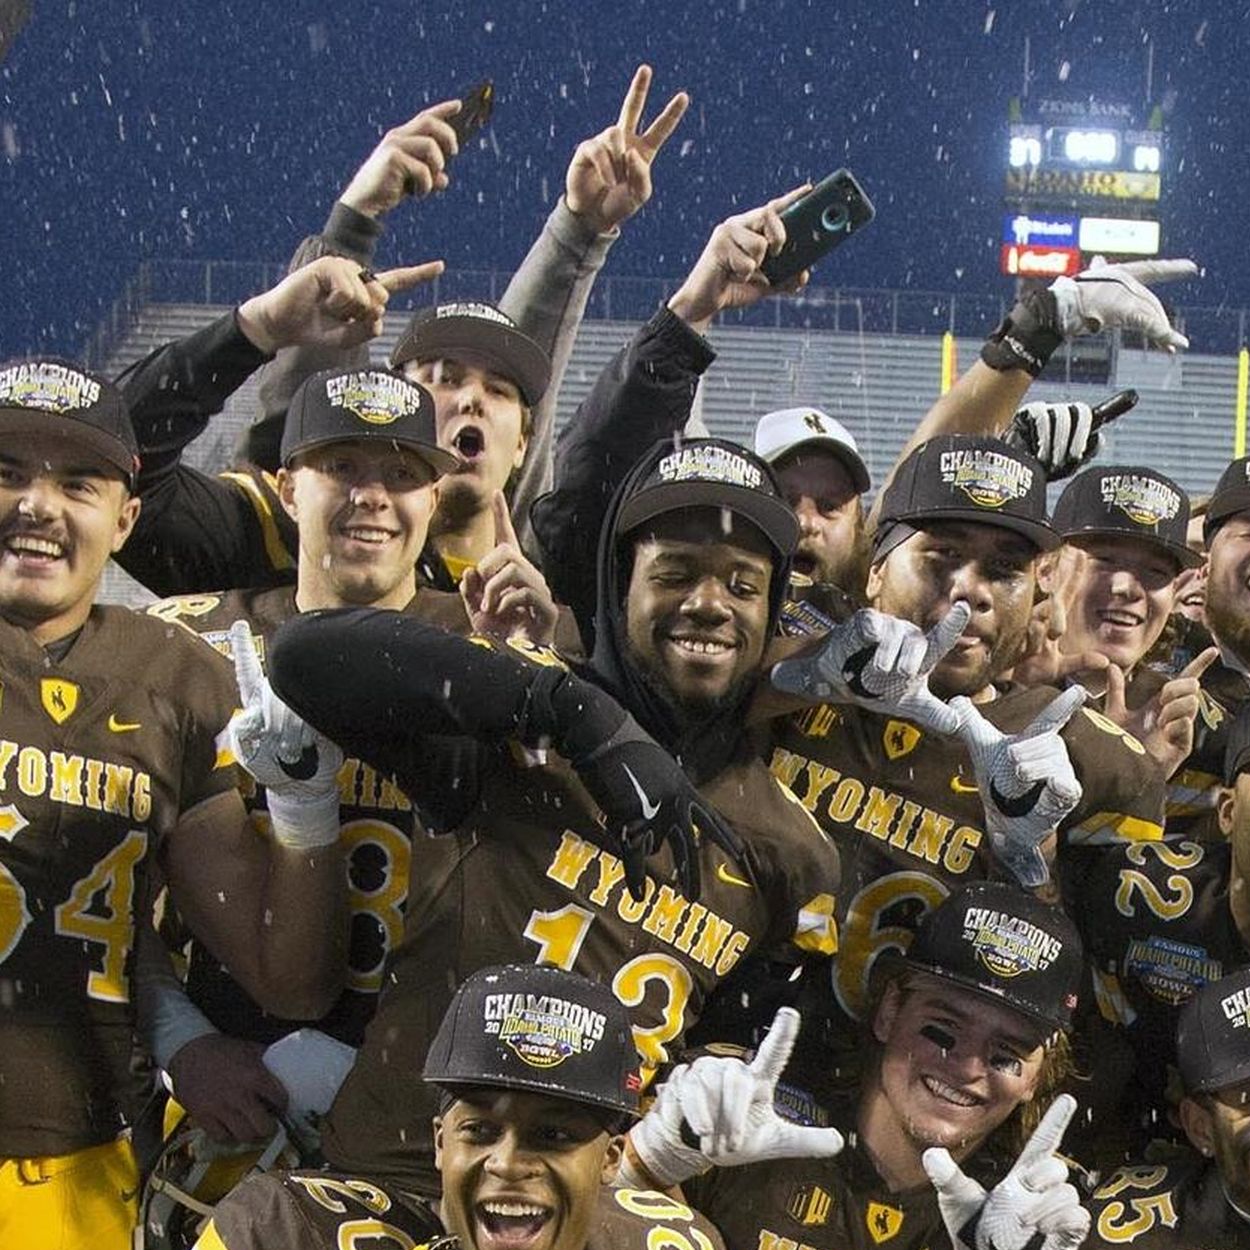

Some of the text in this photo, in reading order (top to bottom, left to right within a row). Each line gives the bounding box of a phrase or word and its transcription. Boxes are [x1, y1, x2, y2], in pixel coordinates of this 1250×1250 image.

[327, 372, 420, 408] CHAMPIONS
[940, 450, 1033, 488] CHAMPIONS
[768, 746, 984, 874] WYOMING
[546, 829, 752, 977] WYOMING
[963, 907, 1063, 962] CHAMPIONS
[484, 1021, 500, 1034] 20
[485, 993, 607, 1041] CHAMPIONS
